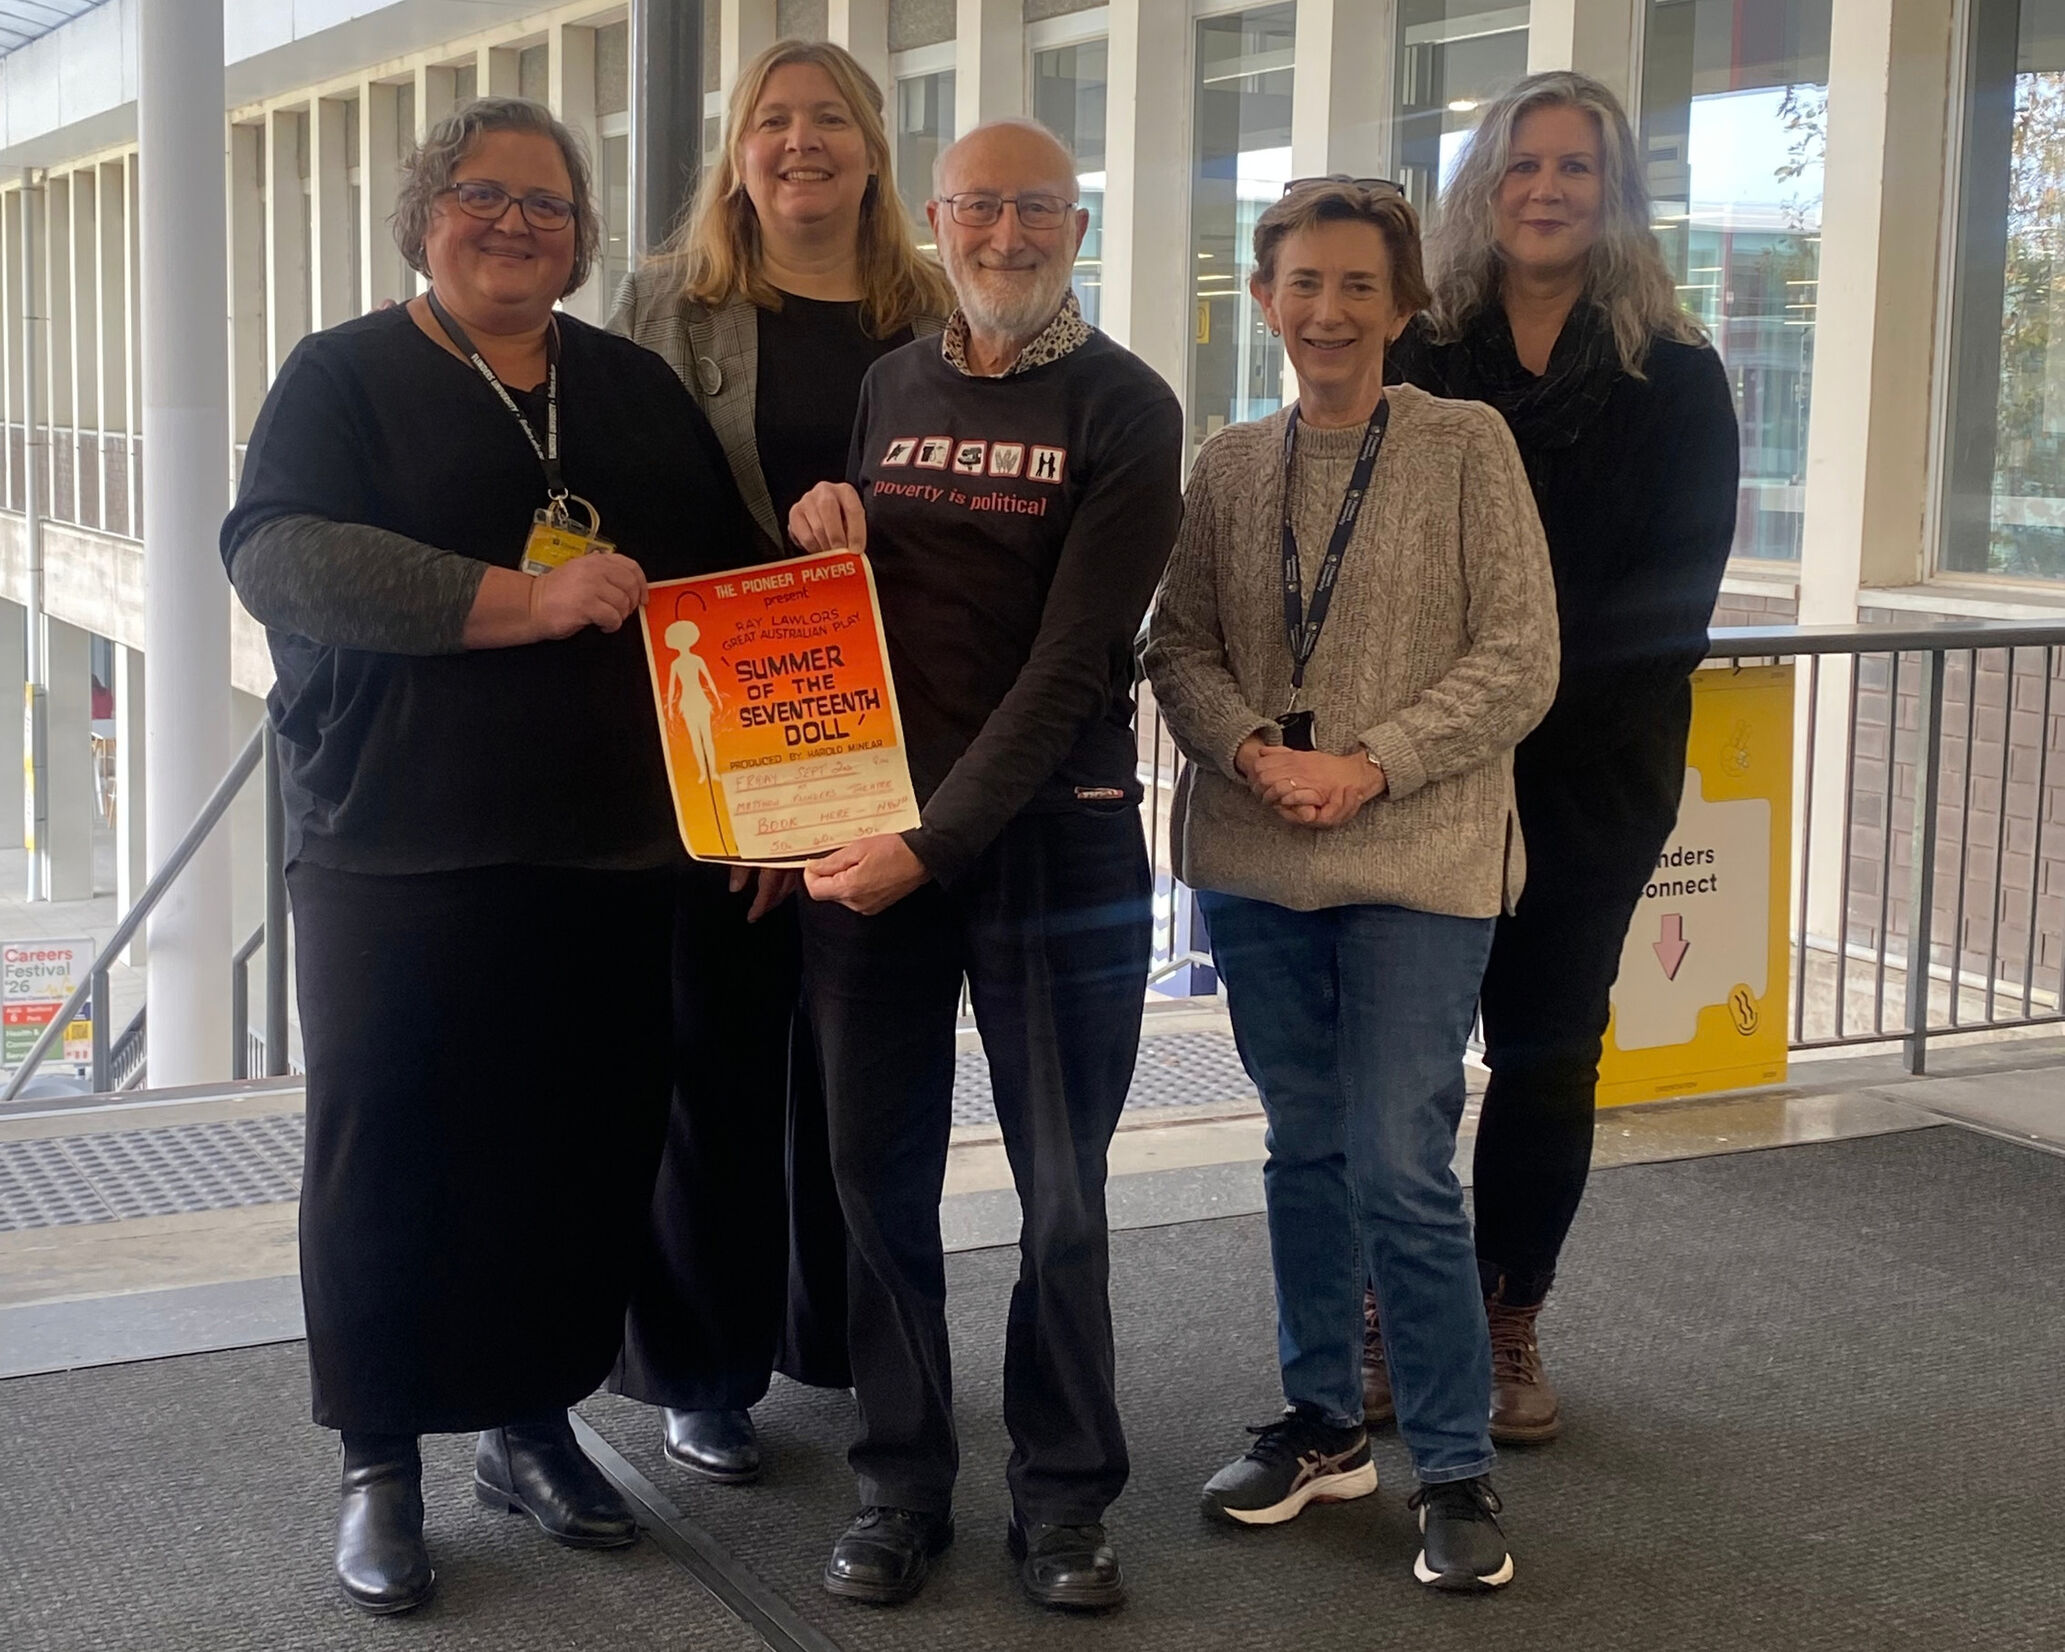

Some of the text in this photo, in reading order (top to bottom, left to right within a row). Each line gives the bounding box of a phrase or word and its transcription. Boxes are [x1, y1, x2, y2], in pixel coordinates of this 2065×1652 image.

[873, 480, 1047, 517] poverty is political
[714, 561, 856, 600] THE PIONEER PLAYERS
[763, 586, 809, 609] present
[722, 611, 861, 651] GREAT AUSTRALIAN PLAY
[735, 617, 763, 632] RAY
[747, 673, 836, 700] OF THE
[739, 687, 881, 728] SEVENTEENTH
[729, 754, 783, 770] PRODUCED
[789, 751, 802, 762] BY
[807, 745, 844, 759] HAROLD
[757, 816, 799, 834] BOOK
[819, 807, 850, 822] HERE
[1656, 846, 1715, 868] nders
[1643, 873, 1717, 899] onnect
[5, 949, 73, 963] Careers
[5, 961, 71, 978] Festival
